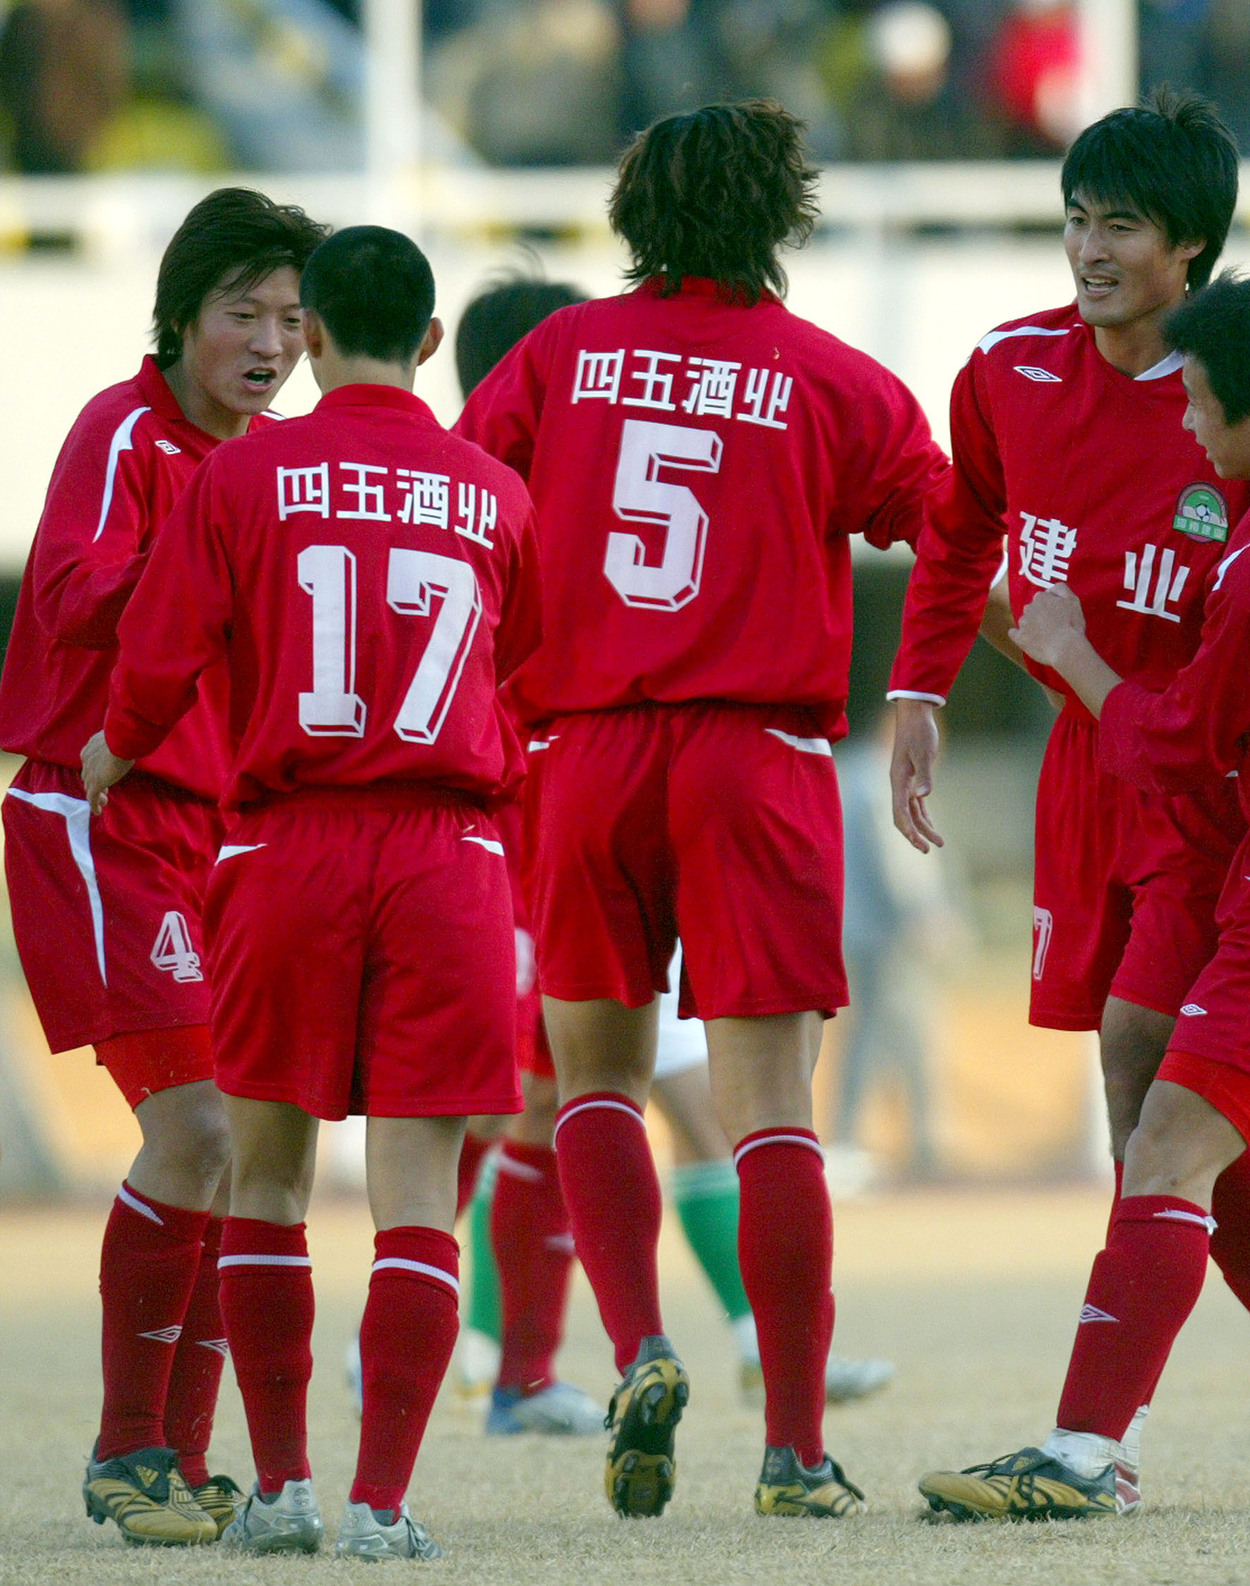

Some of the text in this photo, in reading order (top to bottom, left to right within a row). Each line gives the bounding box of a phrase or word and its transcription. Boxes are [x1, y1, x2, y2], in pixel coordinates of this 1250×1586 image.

[571, 348, 793, 430] 四五酒业
[276, 461, 497, 550] 四五酒业
[603, 418, 724, 613] 5
[297, 544, 482, 746] 17
[149, 910, 204, 983] 4
